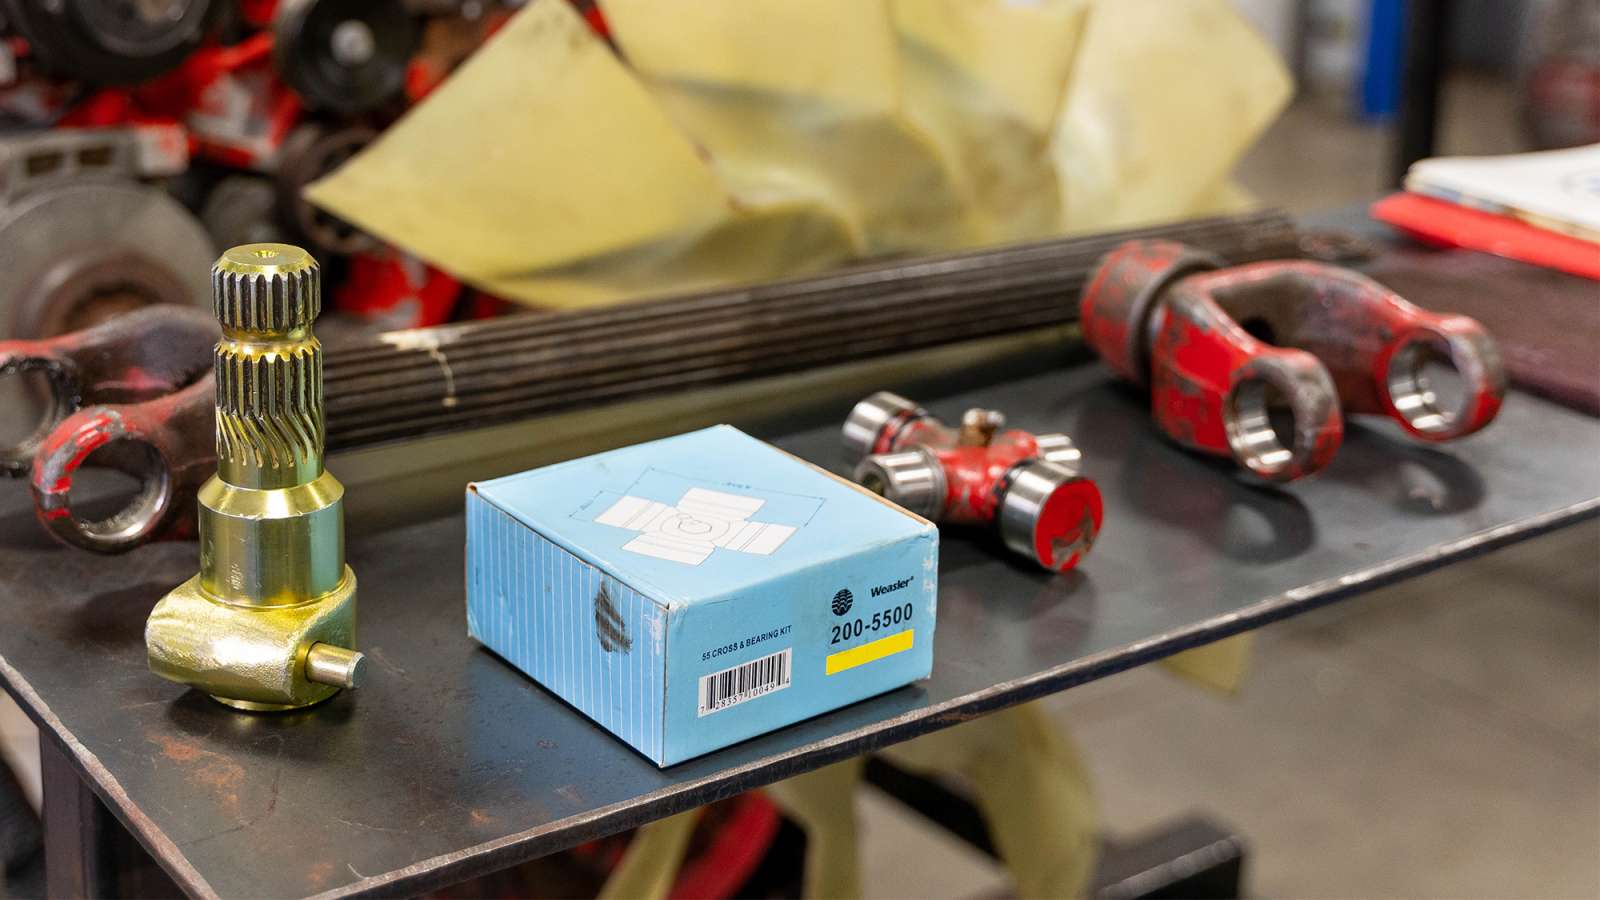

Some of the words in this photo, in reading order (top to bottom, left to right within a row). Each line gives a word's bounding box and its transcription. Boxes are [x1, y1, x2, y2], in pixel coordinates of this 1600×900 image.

[831, 602, 913, 644] 200-5500
[702, 651, 711, 661] 55
[712, 641, 738, 659] CROSS
[739, 641, 745, 649] &
[745, 629, 779, 647] BEARING
[779, 625, 792, 636] KIT
